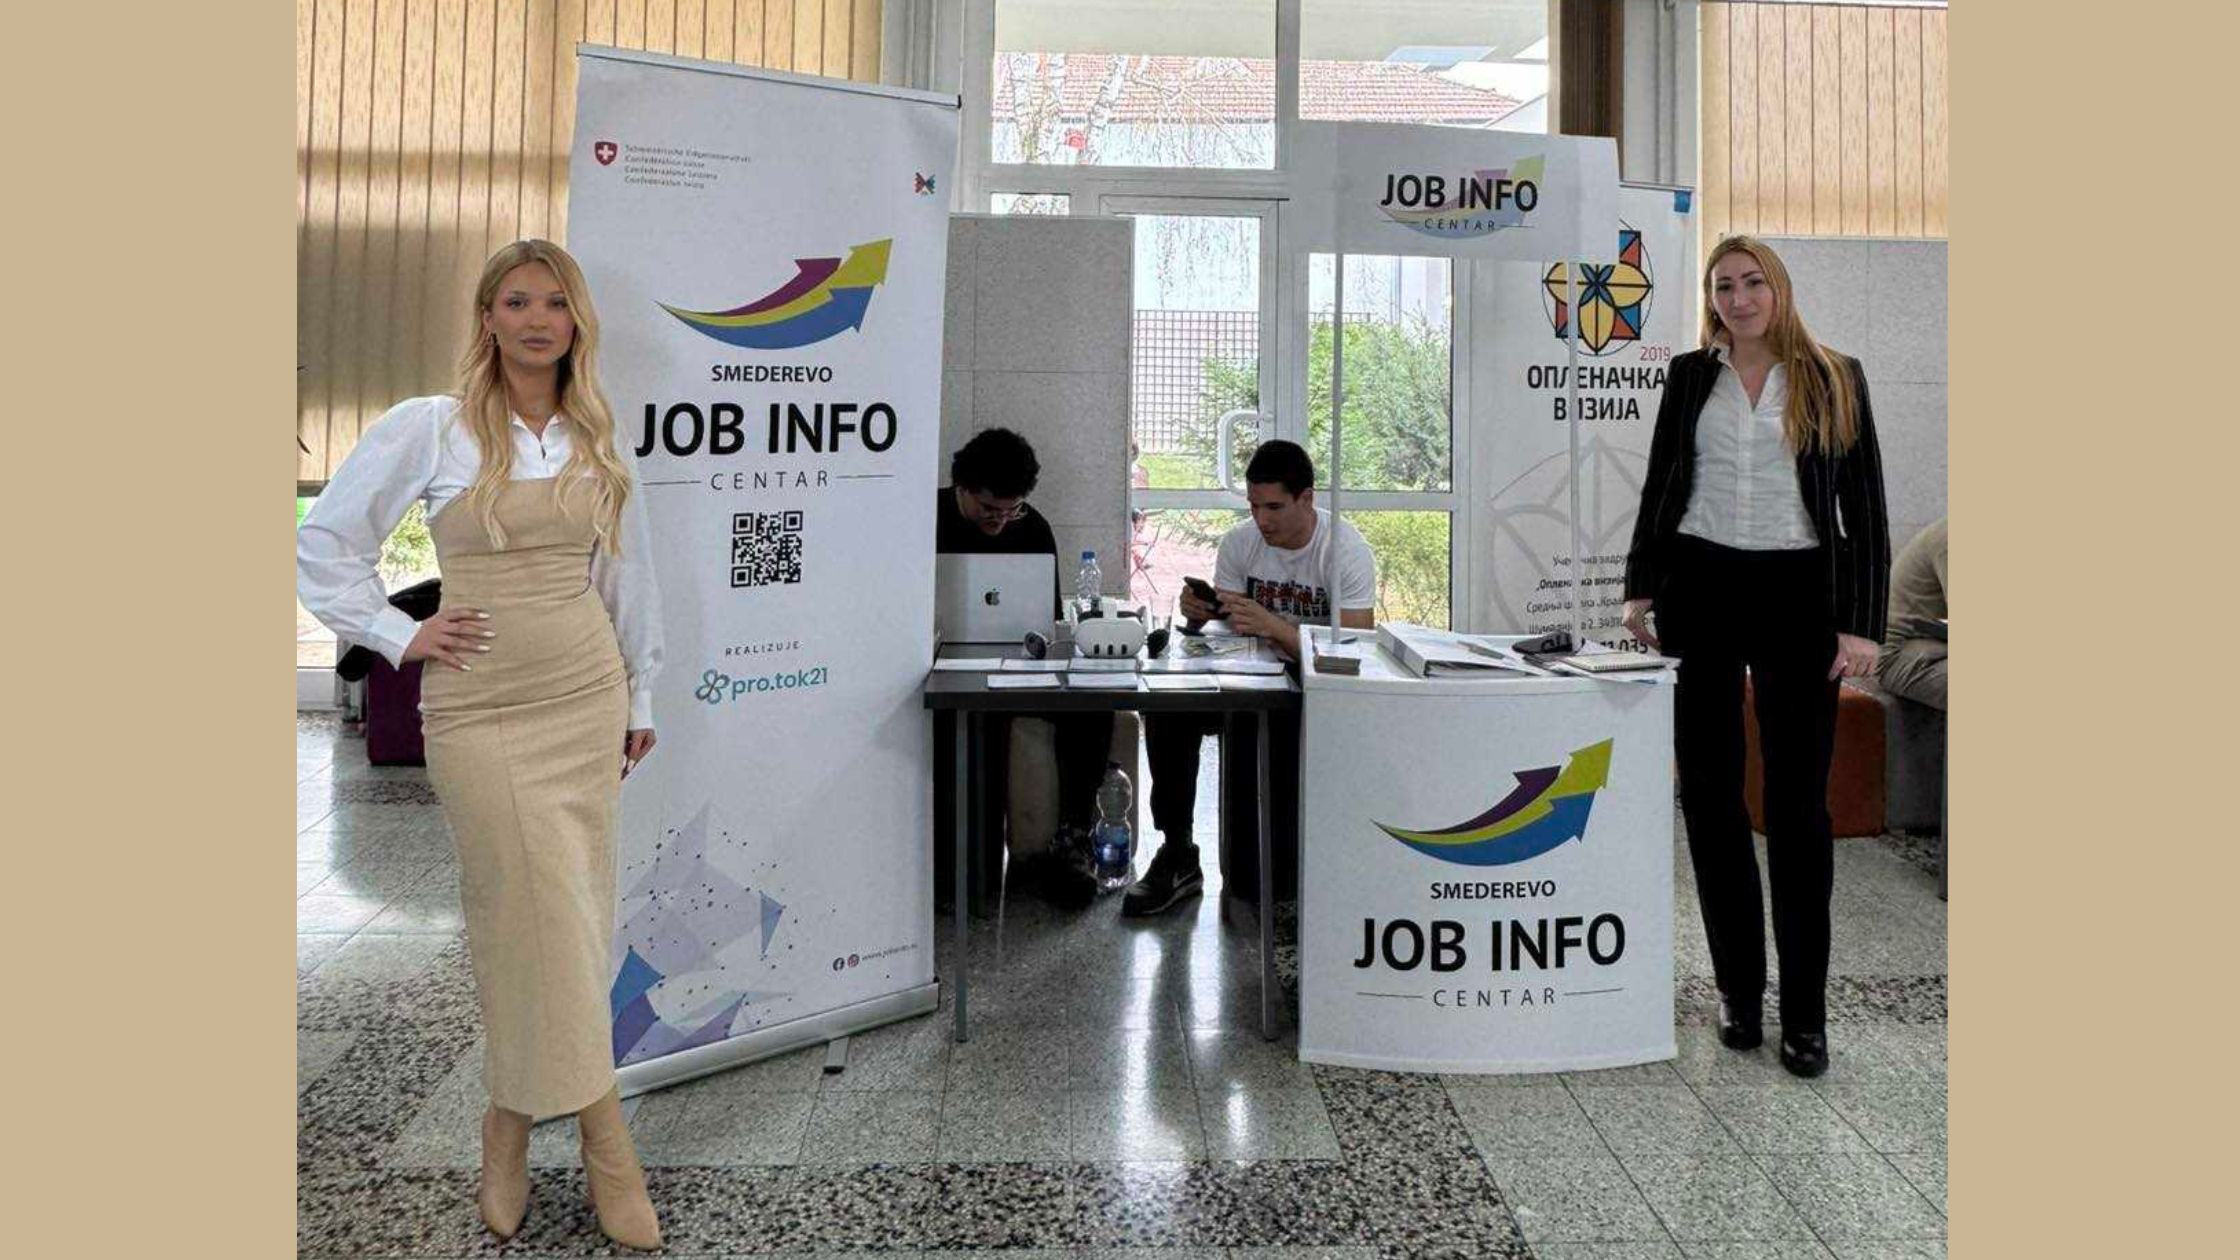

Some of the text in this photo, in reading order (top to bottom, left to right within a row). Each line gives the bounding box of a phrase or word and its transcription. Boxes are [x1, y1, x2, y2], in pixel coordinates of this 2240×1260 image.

[1381, 174, 1539, 213] JOB INFO
[1424, 218, 1496, 232] CENTAR
[1640, 346, 1671, 361] 2019
[711, 364, 833, 383] SMEDEREVO
[635, 402, 898, 458] JOB INFO
[710, 470, 829, 491] CENTAR
[732, 666, 828, 700] pro.tok21
[1430, 880, 1557, 900] SMEDEREVO
[1353, 912, 1626, 972] JOB INFO
[1433, 987, 1556, 1007] CENTAR
